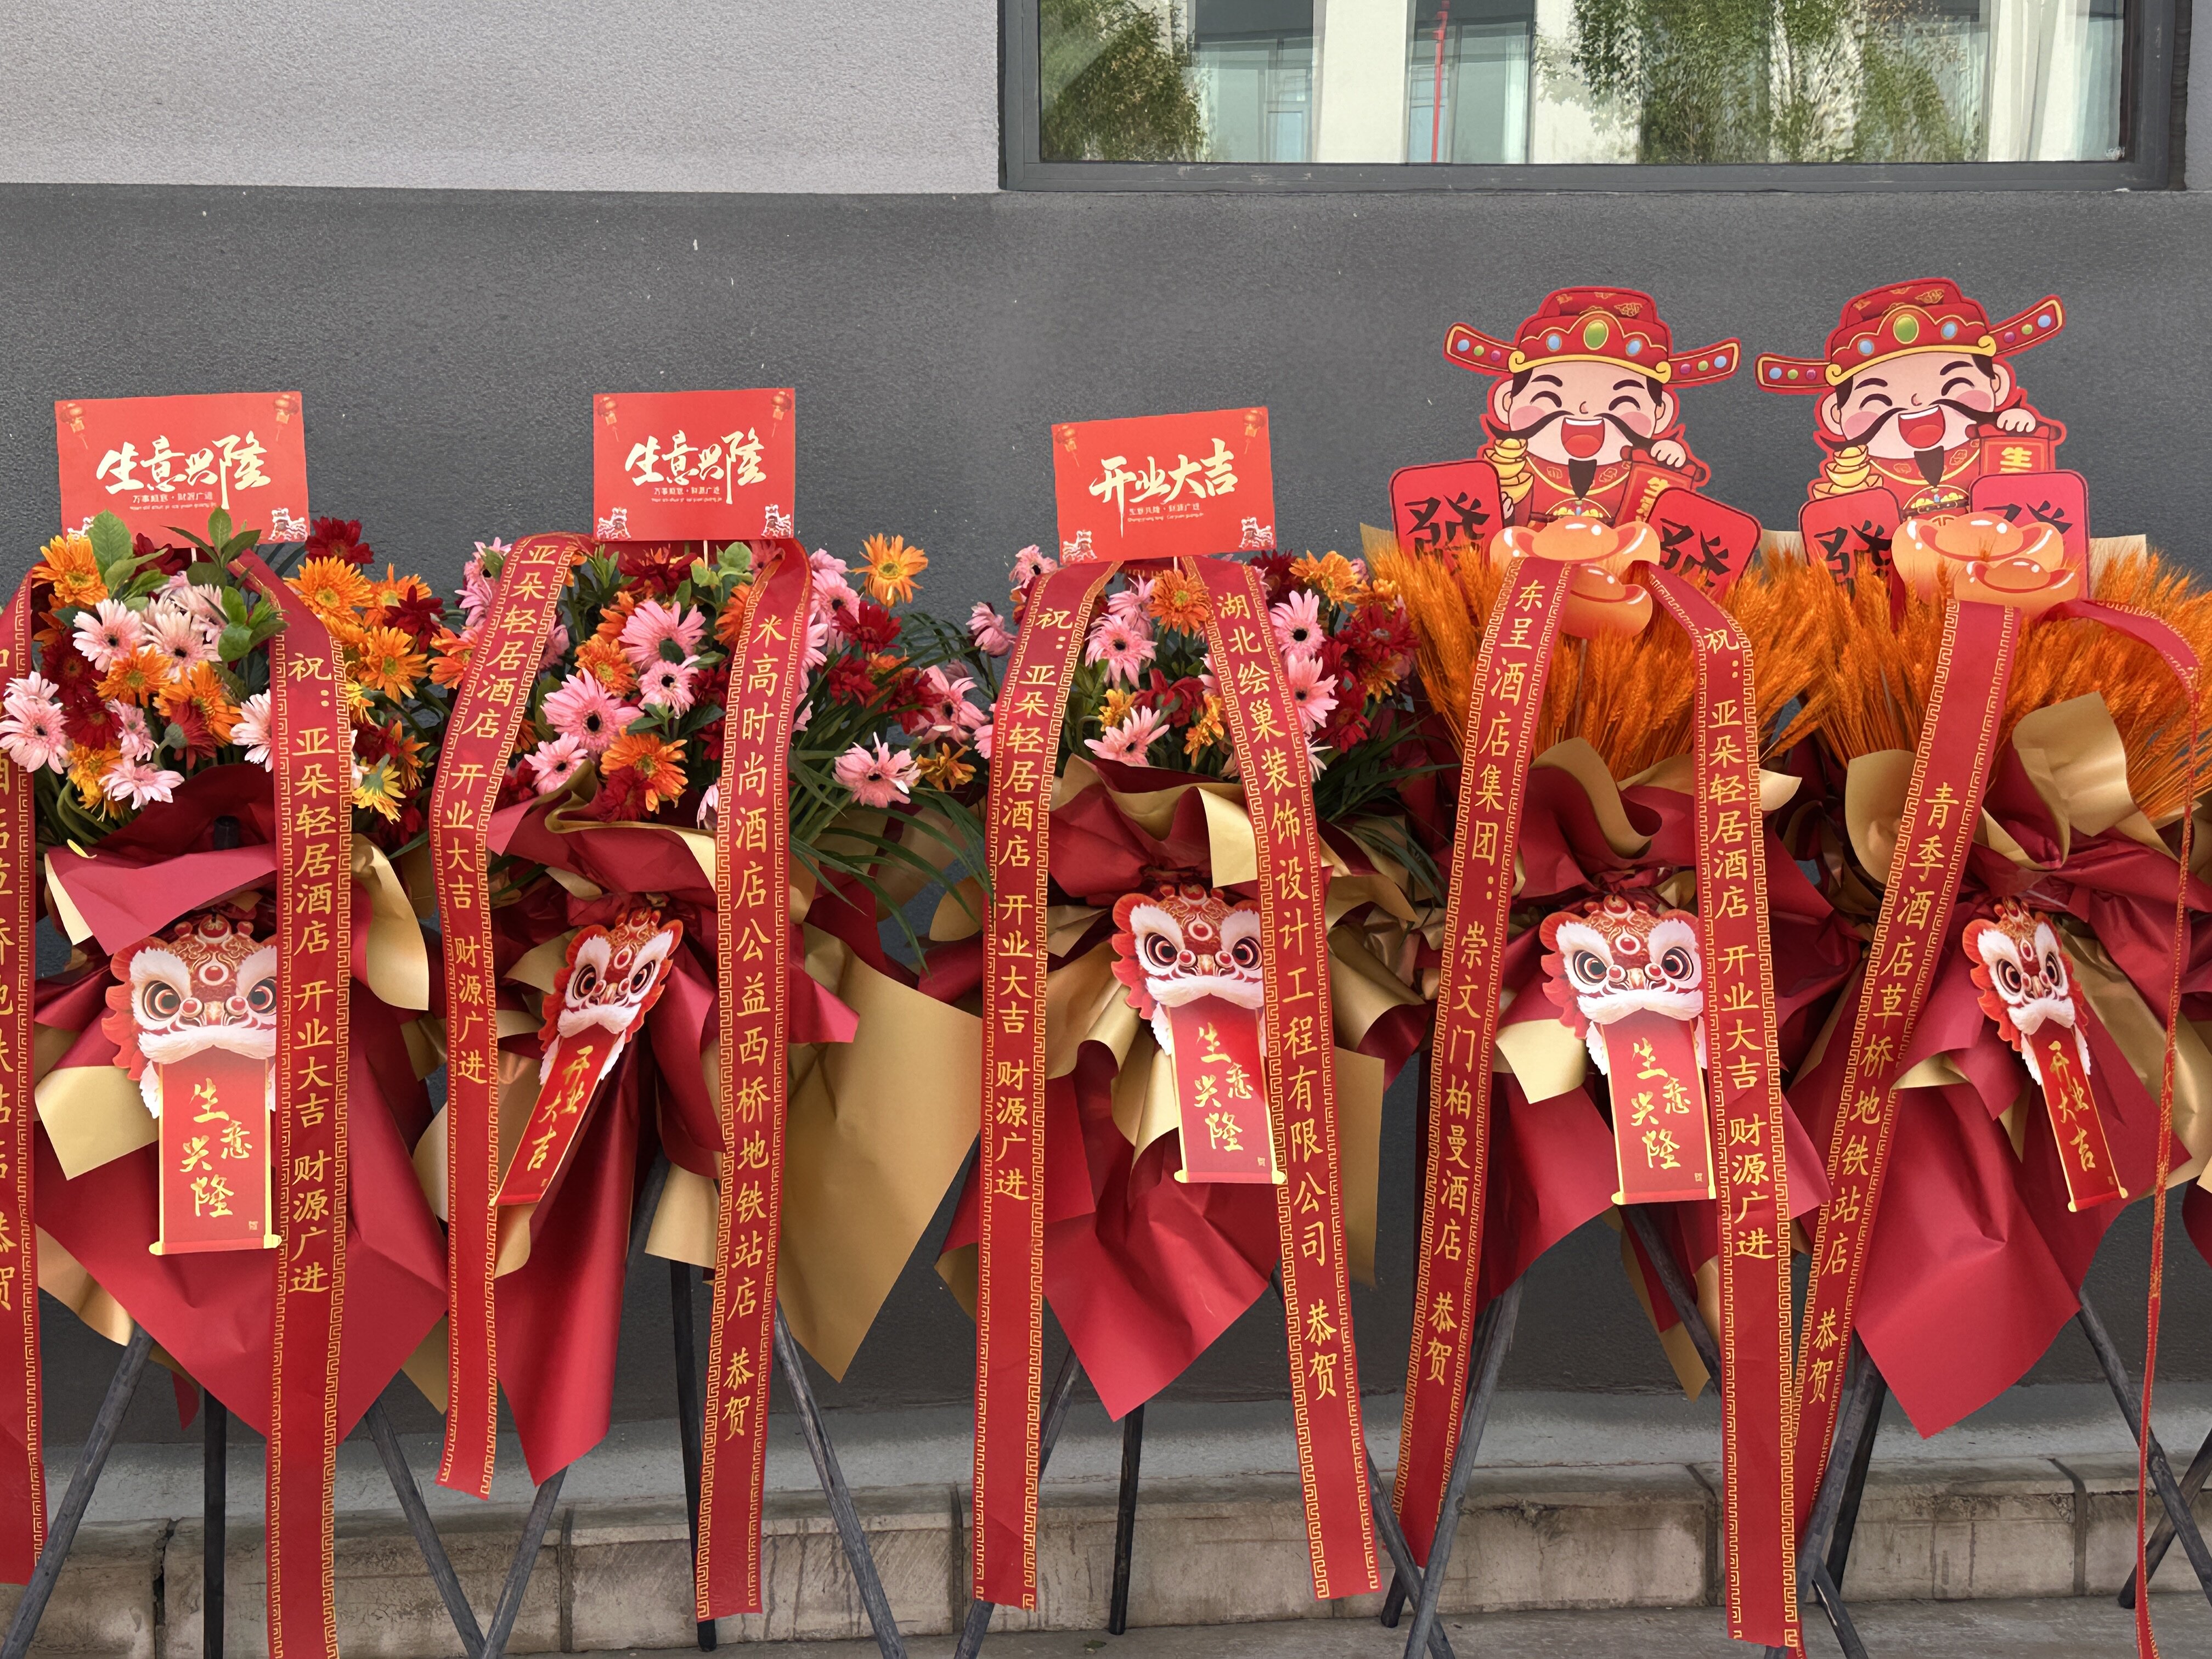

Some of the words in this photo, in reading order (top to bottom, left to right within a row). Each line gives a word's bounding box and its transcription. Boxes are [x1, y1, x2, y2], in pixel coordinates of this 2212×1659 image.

[96, 430, 272, 510] 生意兴隆
[625, 427, 767, 505] 生意兴隆
[1088, 438, 1239, 538] 开业大吉
[461, 544, 557, 738] 亚朵轻居酒店
[287, 653, 336, 956] 祝：亚朵轻居酒店
[998, 607, 1074, 868] 祝：亚朵轻居酒店
[1704, 628, 1748, 918] 祝：亚朵轻居酒店
[442, 763, 487, 910] 开业大吉
[997, 894, 1034, 1034] 开业大吉
[1433, 579, 1544, 1261] 东呈酒店集团：崇文门柏曼酒店
[293, 979, 335, 1128] 开业大吉
[454, 935, 487, 1085] 财源广进
[1218, 591, 1326, 1266] 湖北绘巢装饰设计工程有限公司
[1304, 1300, 1337, 1401] 恭贺
[1717, 944, 1763, 1090] 开业大吉
[1821, 782, 1960, 1276] 青季酒店草桥地铁站店
[994, 1058, 1030, 1200] 财源广进
[1728, 1113, 1775, 1260] 财源广进
[288, 1150, 333, 1293] 财源广进
[722, 1347, 755, 1442] 恭贺
[1424, 1291, 1457, 1386] 恭贺
[1808, 1307, 1838, 1404] 恭贺
